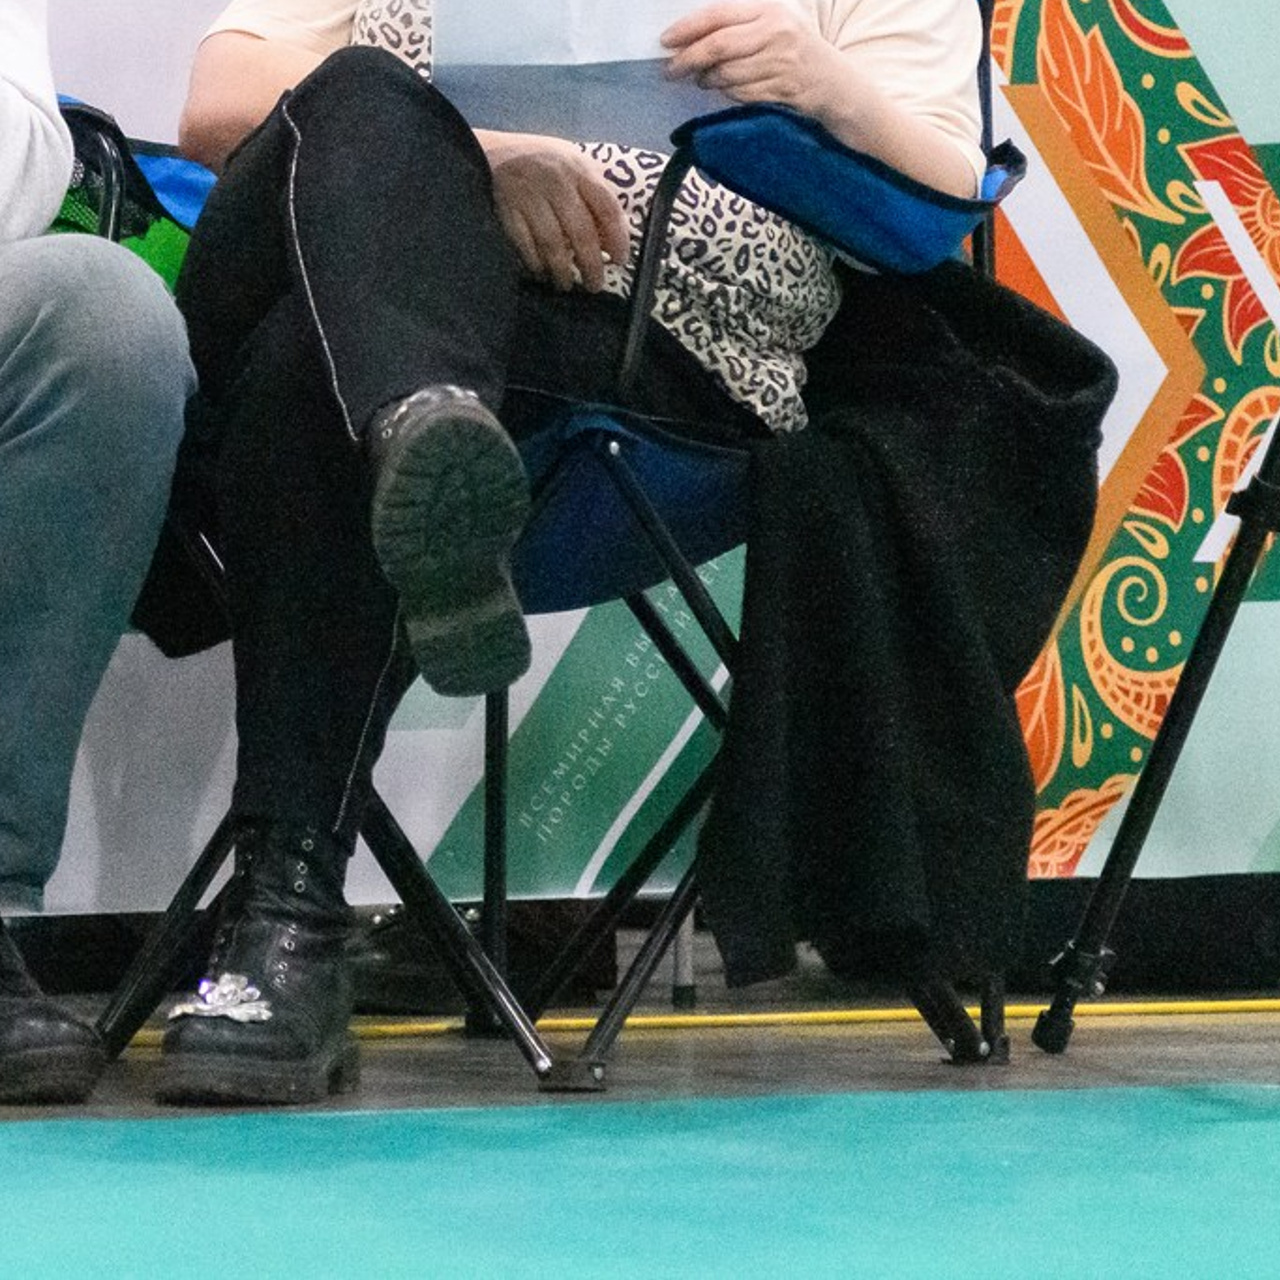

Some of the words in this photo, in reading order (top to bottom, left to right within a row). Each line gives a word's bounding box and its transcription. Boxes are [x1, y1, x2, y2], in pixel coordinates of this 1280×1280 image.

[519, 676, 626, 829] ВСЕМИРНАЯ
[536, 737, 614, 842] ПОРОДЫ
[613, 609, 692, 728] РУССЙ
